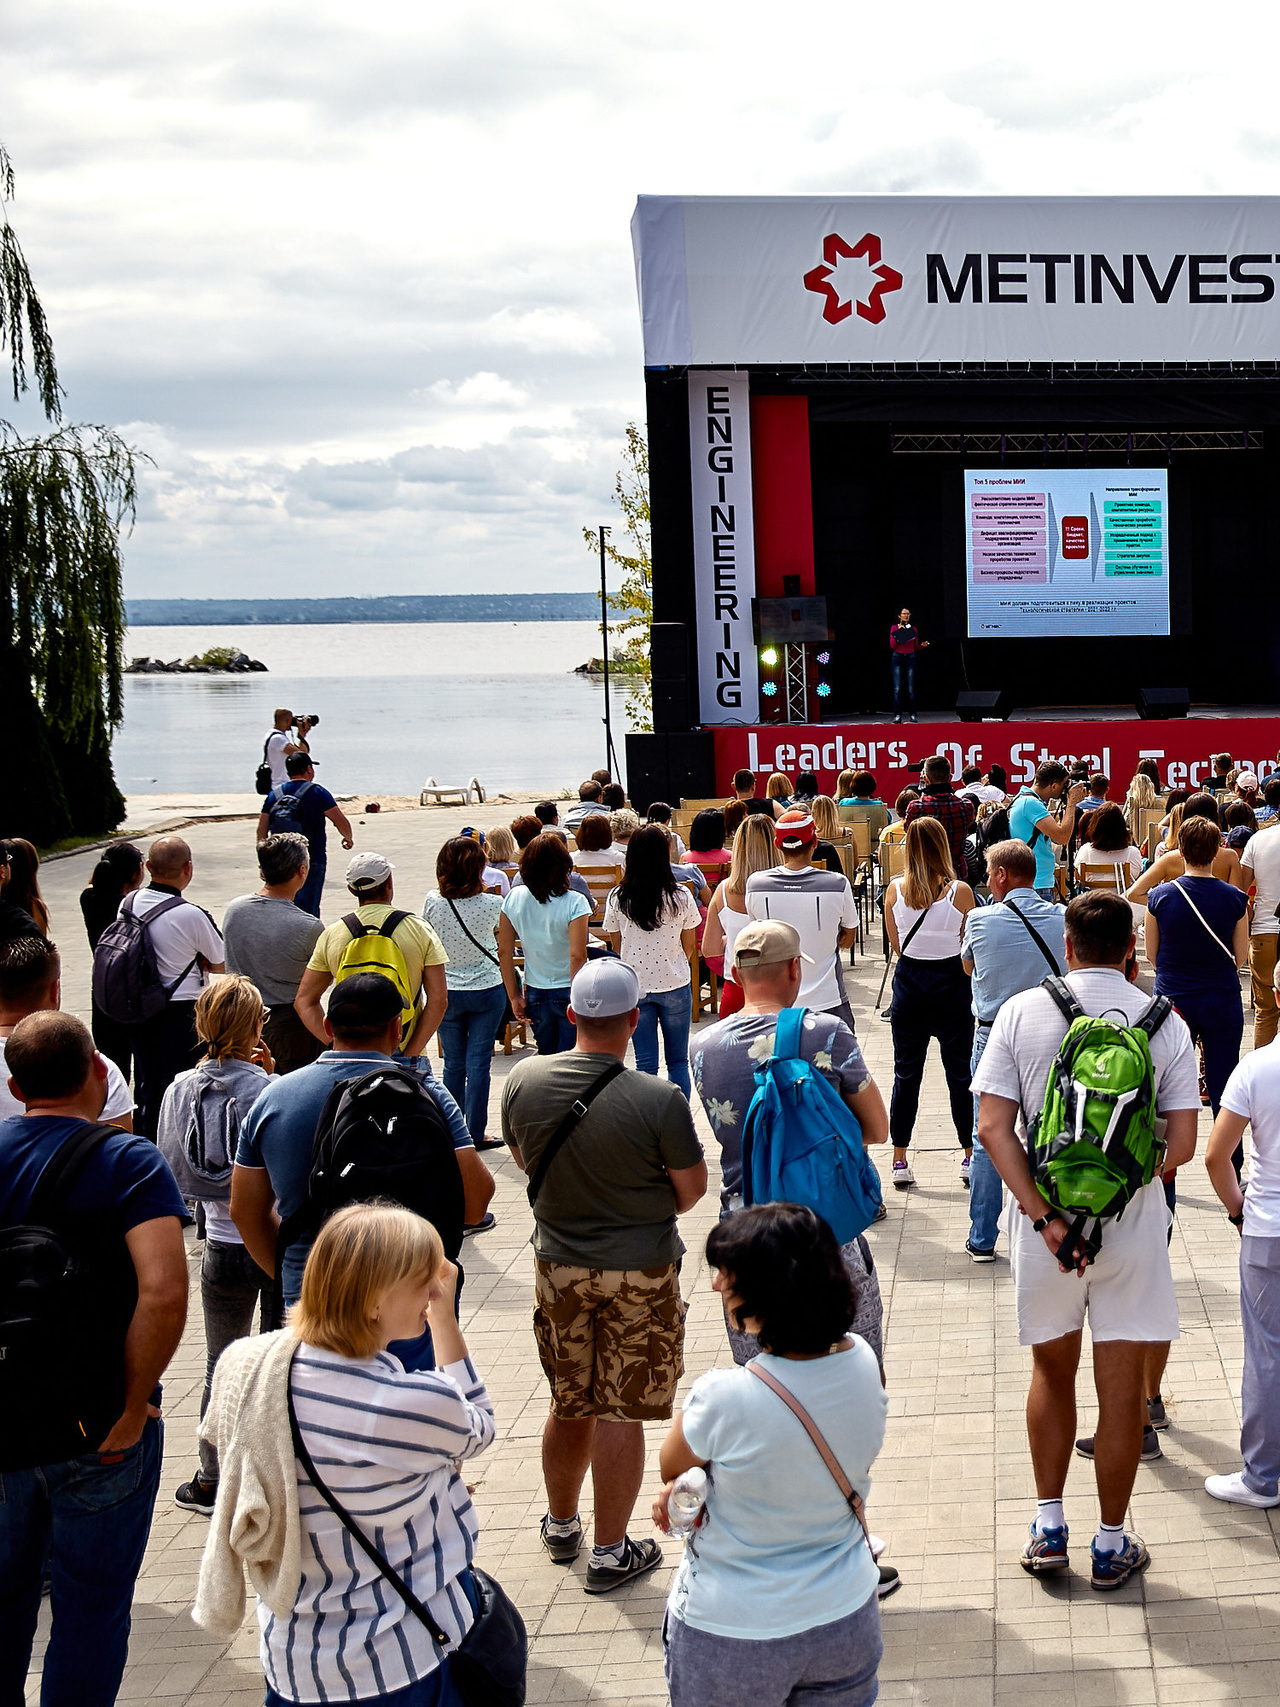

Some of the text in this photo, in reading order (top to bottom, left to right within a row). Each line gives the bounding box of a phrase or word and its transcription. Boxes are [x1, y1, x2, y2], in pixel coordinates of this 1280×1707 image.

[706, 386, 743, 708] ENGINEERING
[747, 732, 909, 773] Leaders
[935, 742, 983, 783] Of
